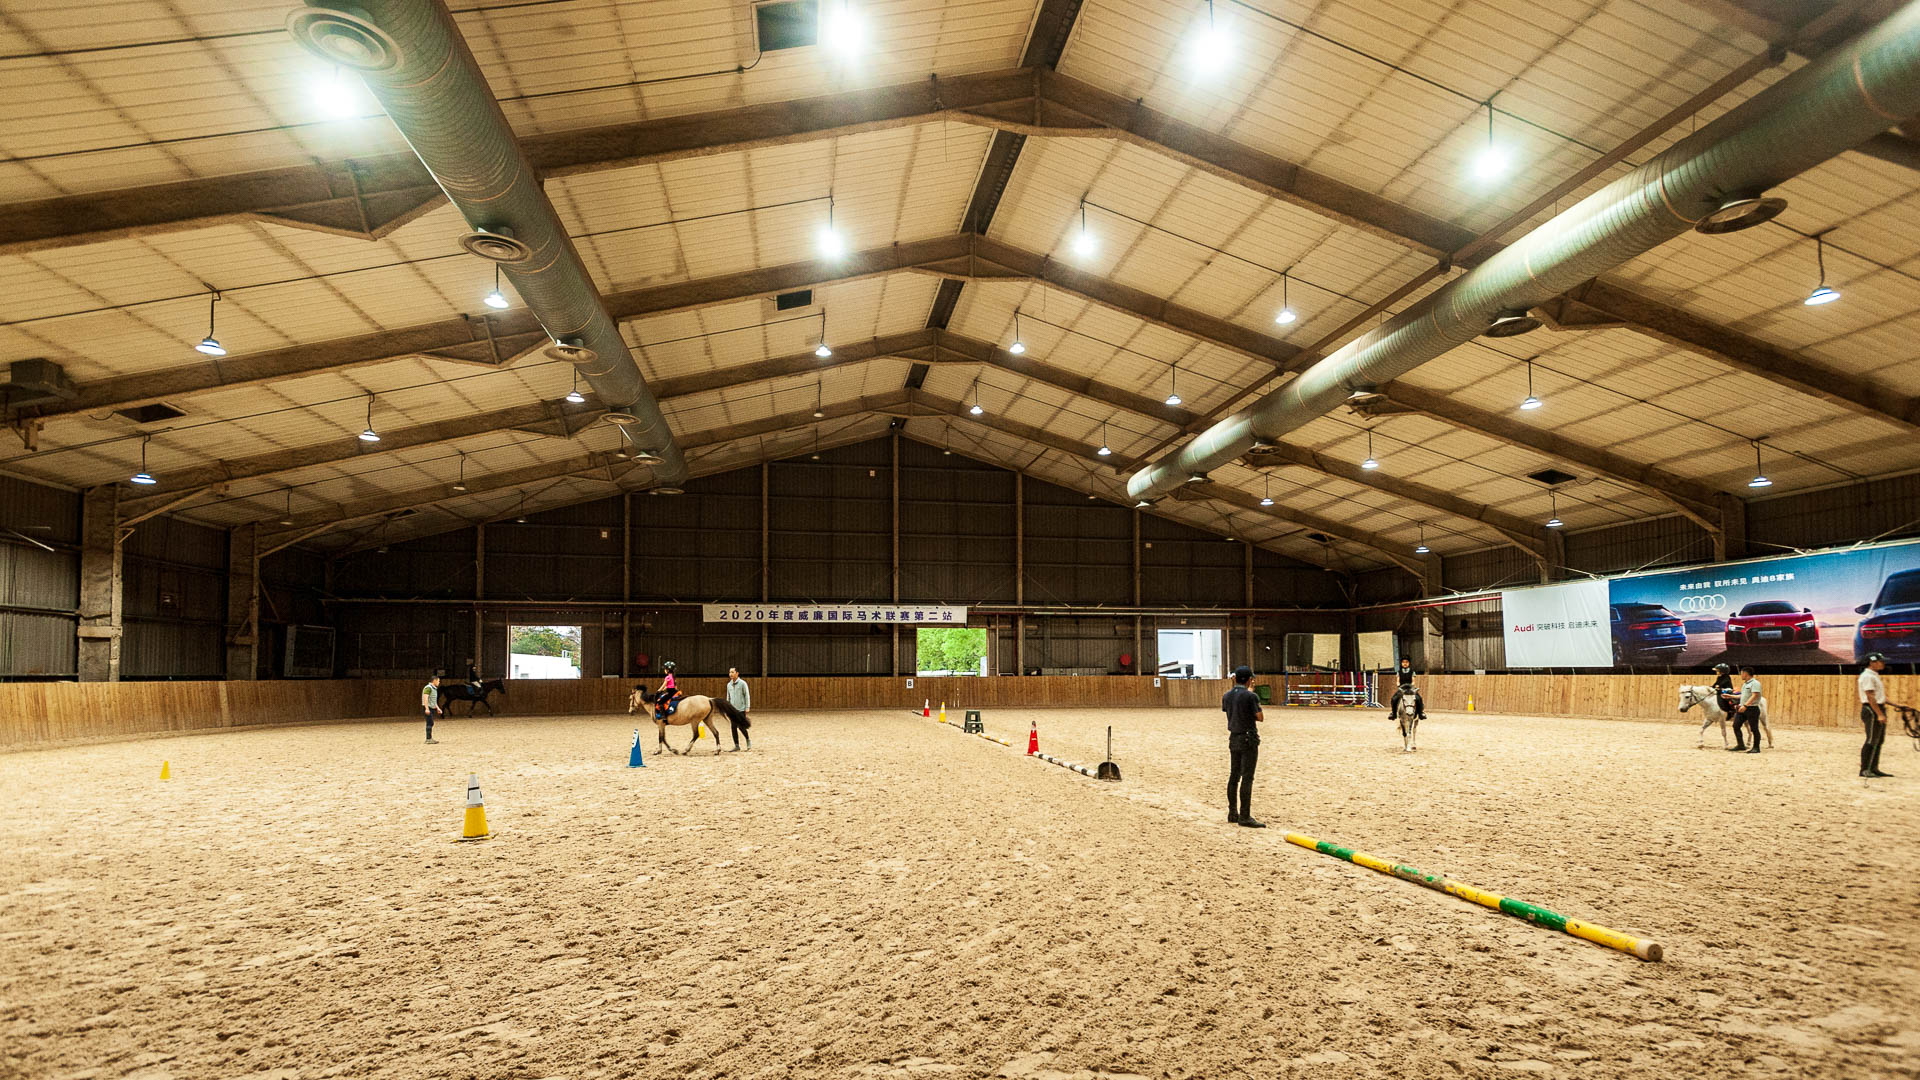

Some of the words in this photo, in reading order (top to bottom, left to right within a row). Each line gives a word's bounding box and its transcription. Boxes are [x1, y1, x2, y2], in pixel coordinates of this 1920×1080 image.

[719, 610, 953, 621] 2020年度威廉国际马术联赛第二站
[1513, 623, 1535, 633] Audi
